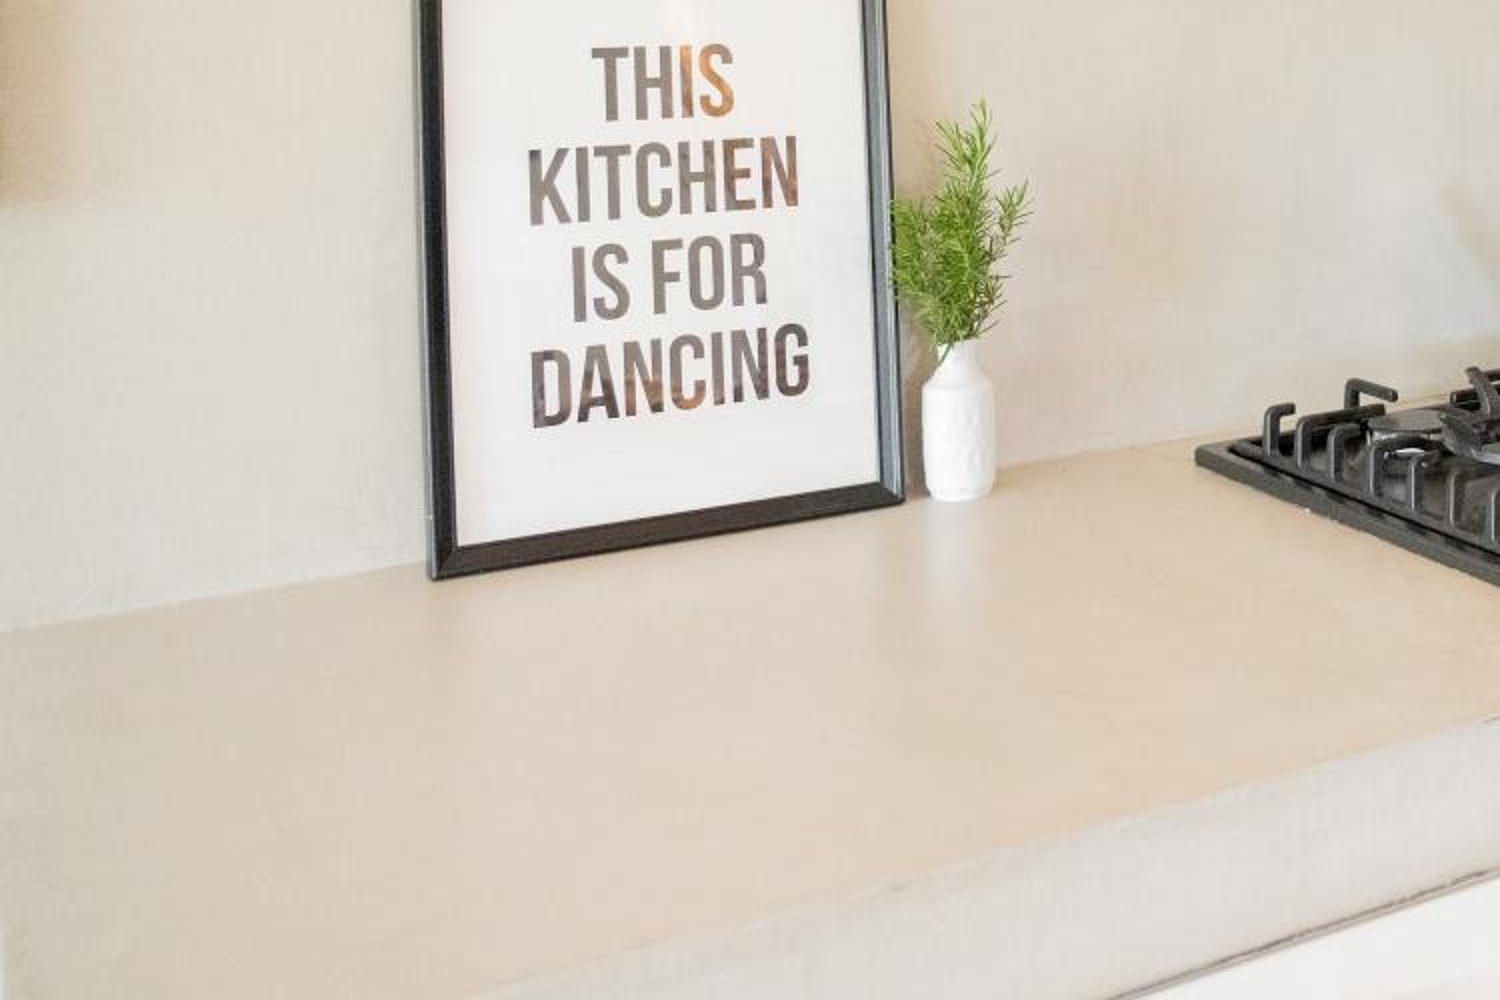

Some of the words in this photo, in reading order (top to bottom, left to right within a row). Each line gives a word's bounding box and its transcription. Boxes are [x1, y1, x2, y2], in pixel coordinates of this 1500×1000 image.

[591, 43, 735, 122] THIS
[527, 135, 799, 227] KITCHEN
[571, 243, 631, 323] IS
[651, 232, 769, 315] FOR
[530, 322, 811, 430] DANCING
